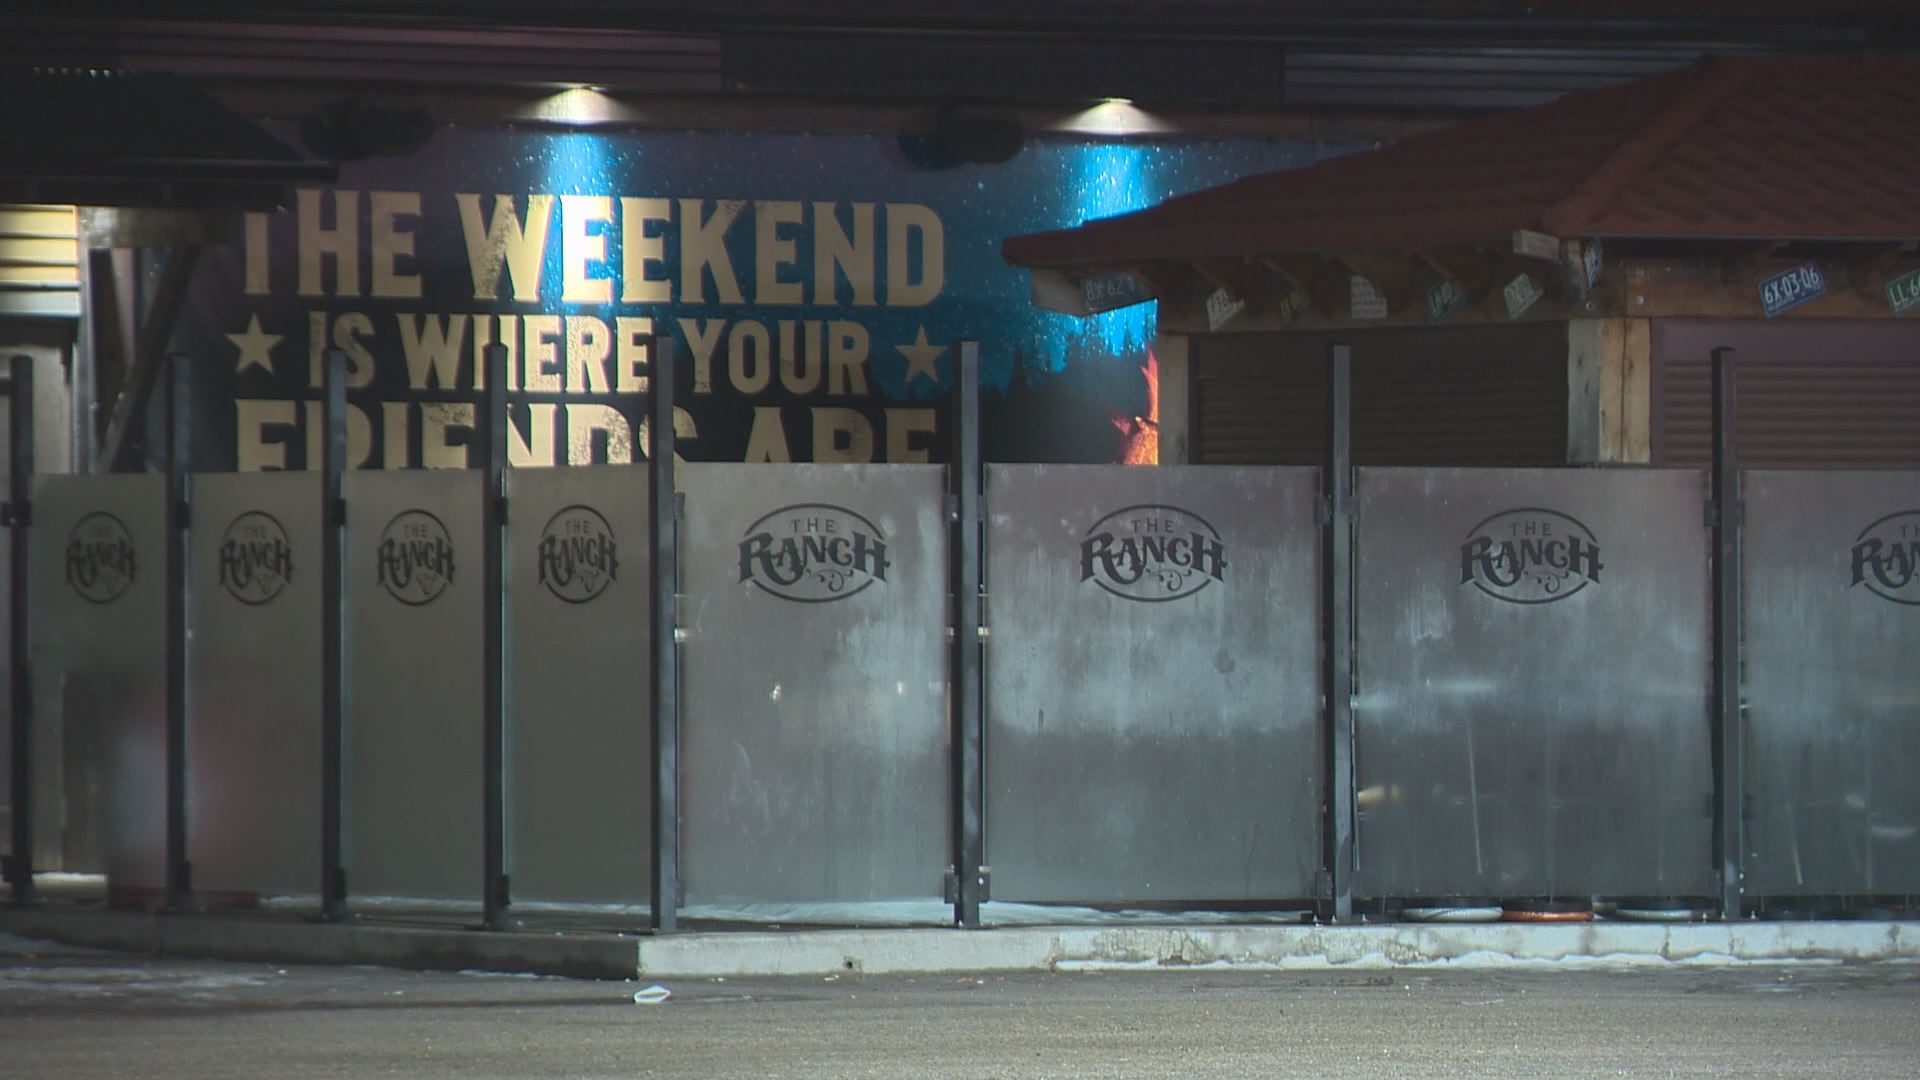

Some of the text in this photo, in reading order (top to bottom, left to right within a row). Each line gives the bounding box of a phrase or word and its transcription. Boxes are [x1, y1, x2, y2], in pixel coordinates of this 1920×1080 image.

[454, 193, 945, 306] WEEKEND
[306, 310, 870, 395] IS WHERE YOUR
[791, 517, 836, 533] THE
[1131, 517, 1175, 533] THE
[1510, 521, 1552, 536] THE
[738, 531, 890, 585] RANCH
[1079, 531, 1227, 585] RANCH
[1461, 534, 1604, 587] RANCH
